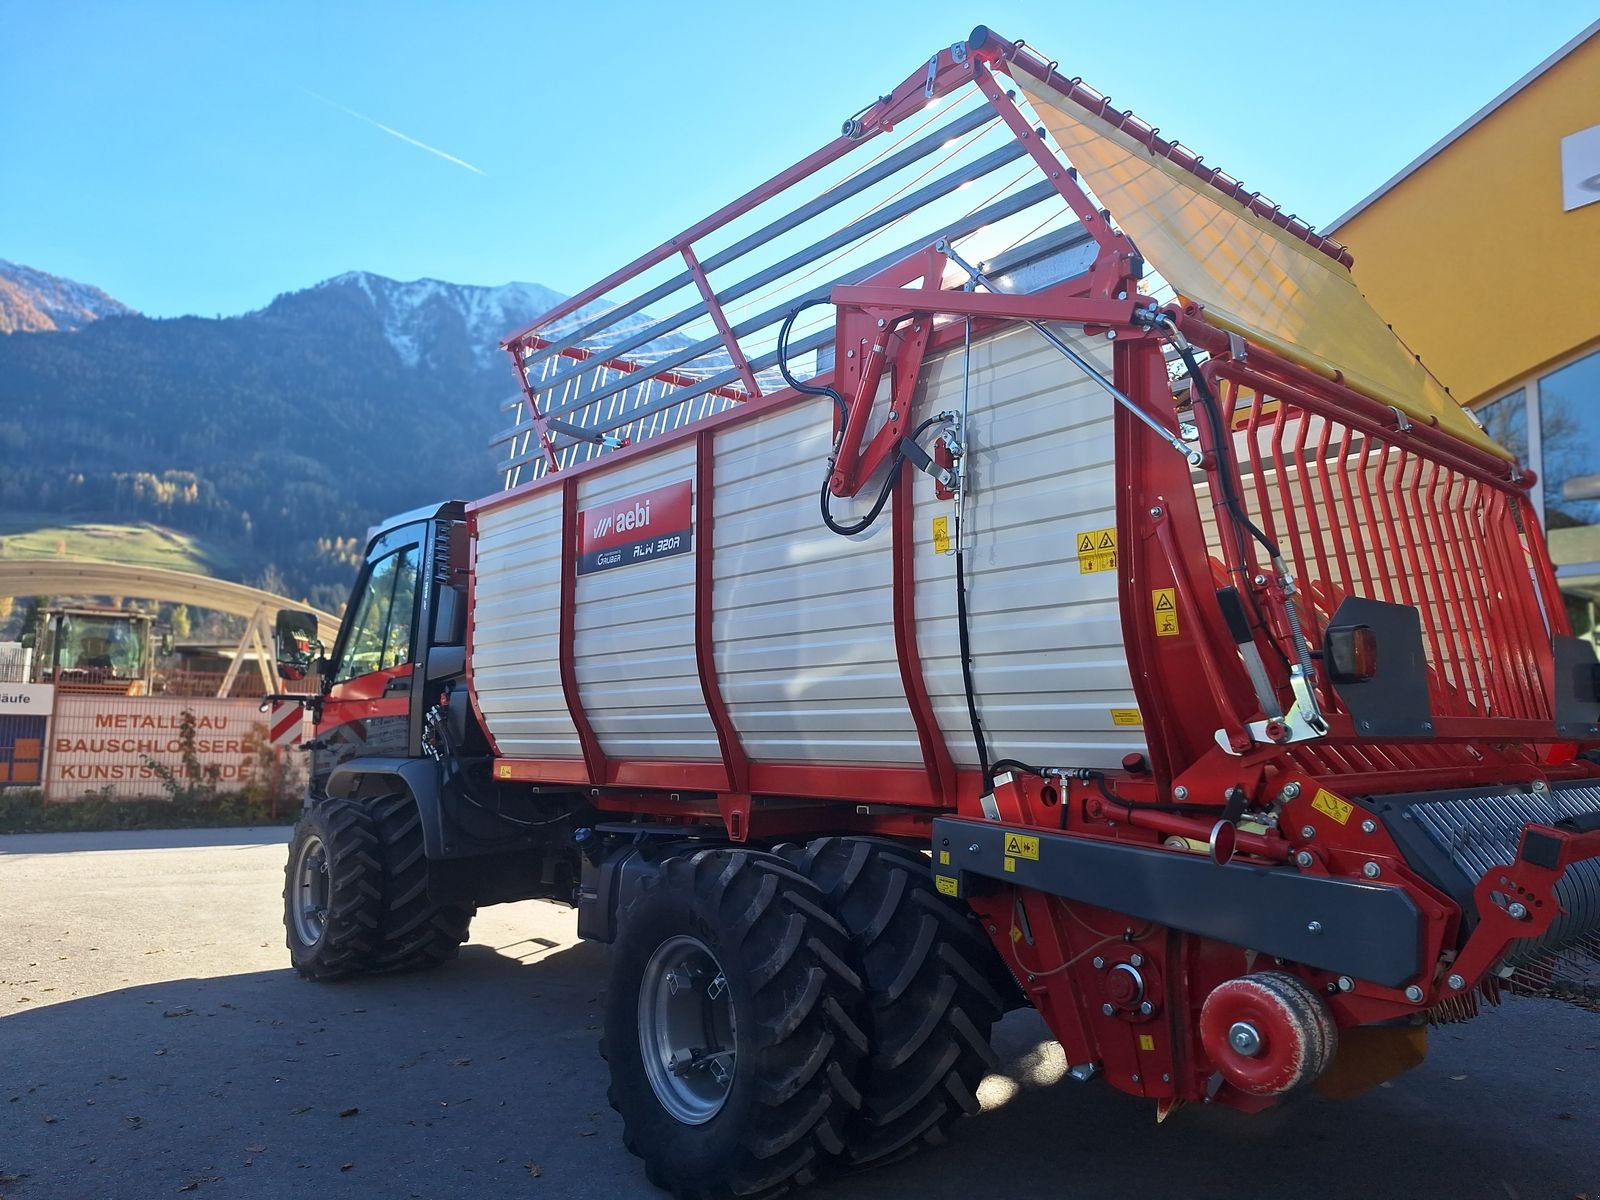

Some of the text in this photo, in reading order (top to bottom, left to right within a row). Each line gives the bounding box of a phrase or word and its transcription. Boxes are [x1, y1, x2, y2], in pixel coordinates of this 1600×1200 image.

[616, 499, 650, 533] aebi
[56, 738, 257, 754] BAUSCHLOSERE
[61, 764, 249, 780] KUNSTSCHIDE
